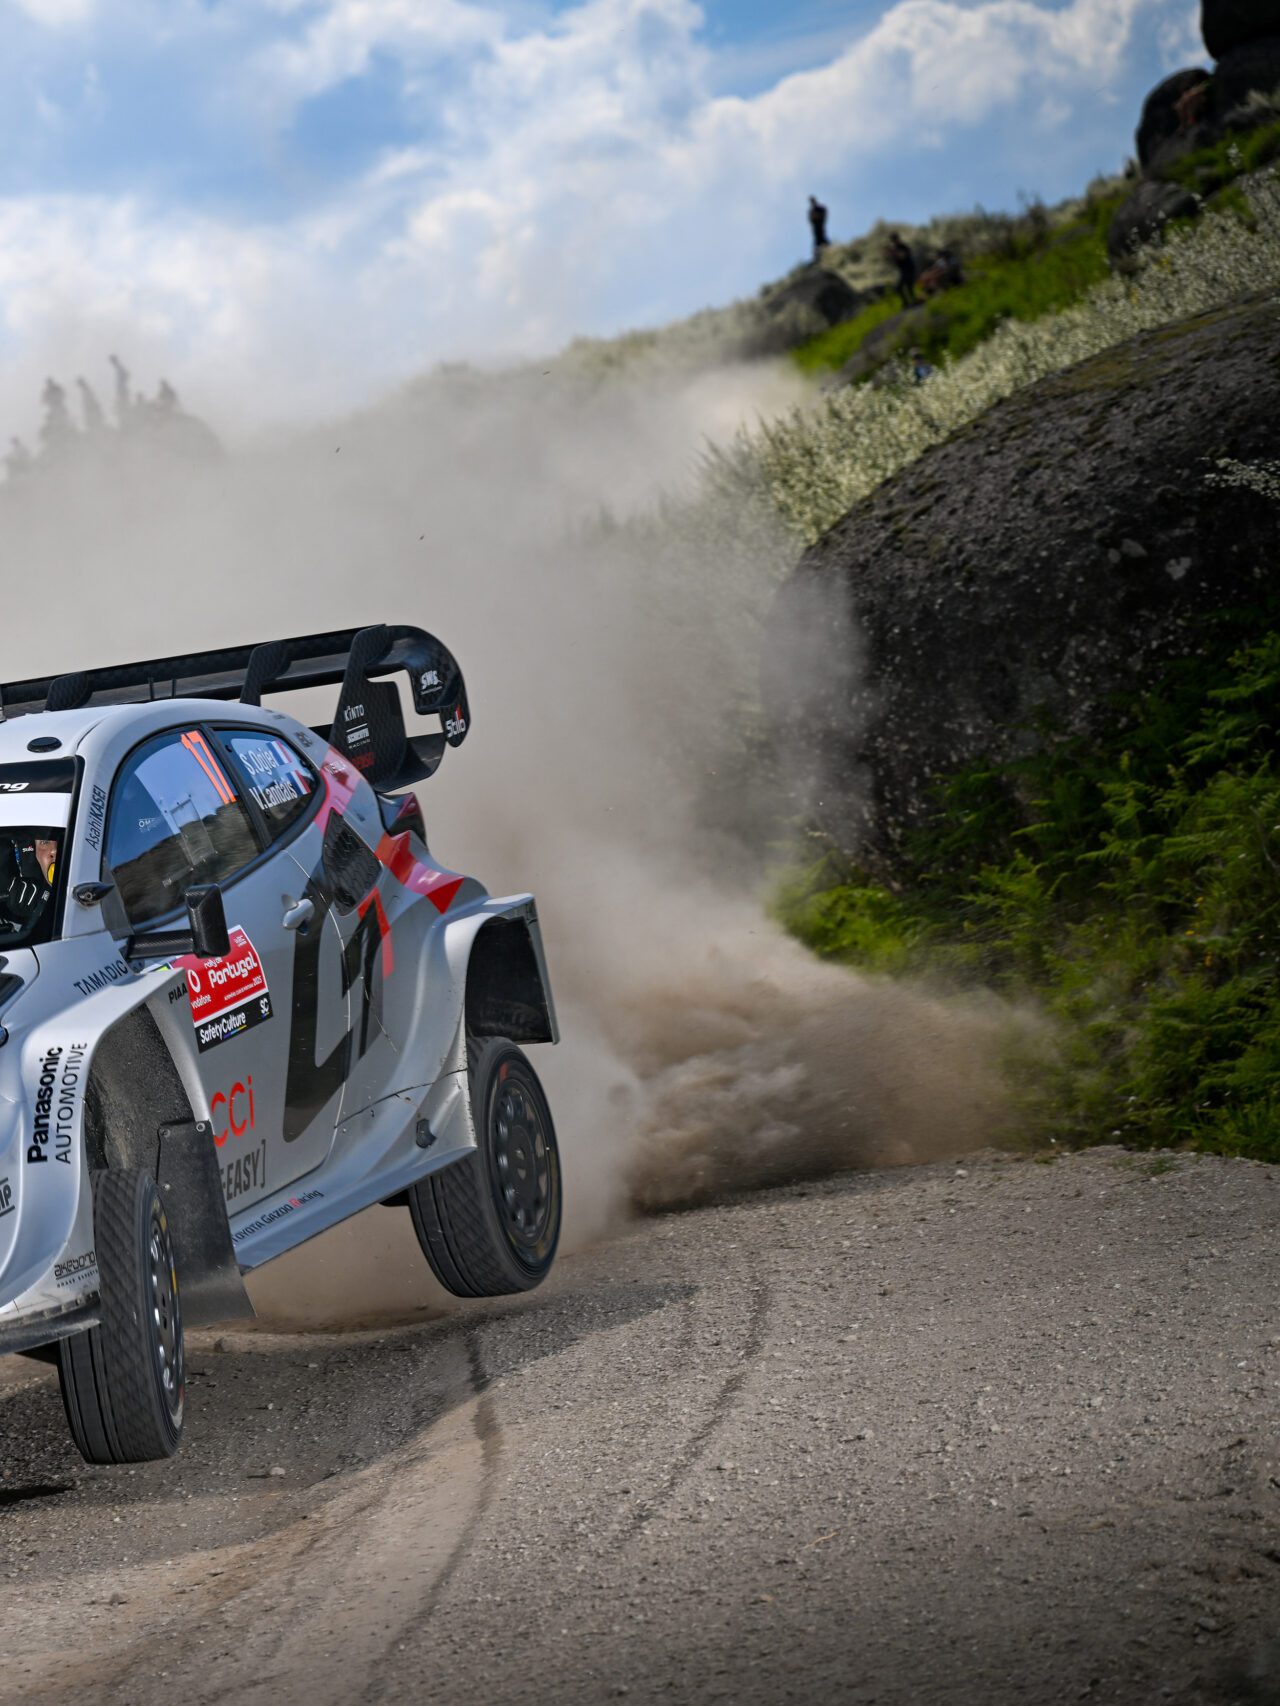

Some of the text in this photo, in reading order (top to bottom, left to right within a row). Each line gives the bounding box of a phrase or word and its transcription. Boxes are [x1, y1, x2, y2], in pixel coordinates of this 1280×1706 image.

[181, 730, 237, 805] 17
[73, 960, 128, 996] TAMADIC
[208, 951, 258, 988] Portugal
[168, 983, 188, 1004] PIAA
[191, 994, 212, 1009] vodafone
[260, 998, 270, 1014] SC
[200, 1012, 246, 1044] SafetyCulture
[27, 1047, 63, 1164] Panasonic
[56, 1042, 87, 1165] AUTOMOTIVE
